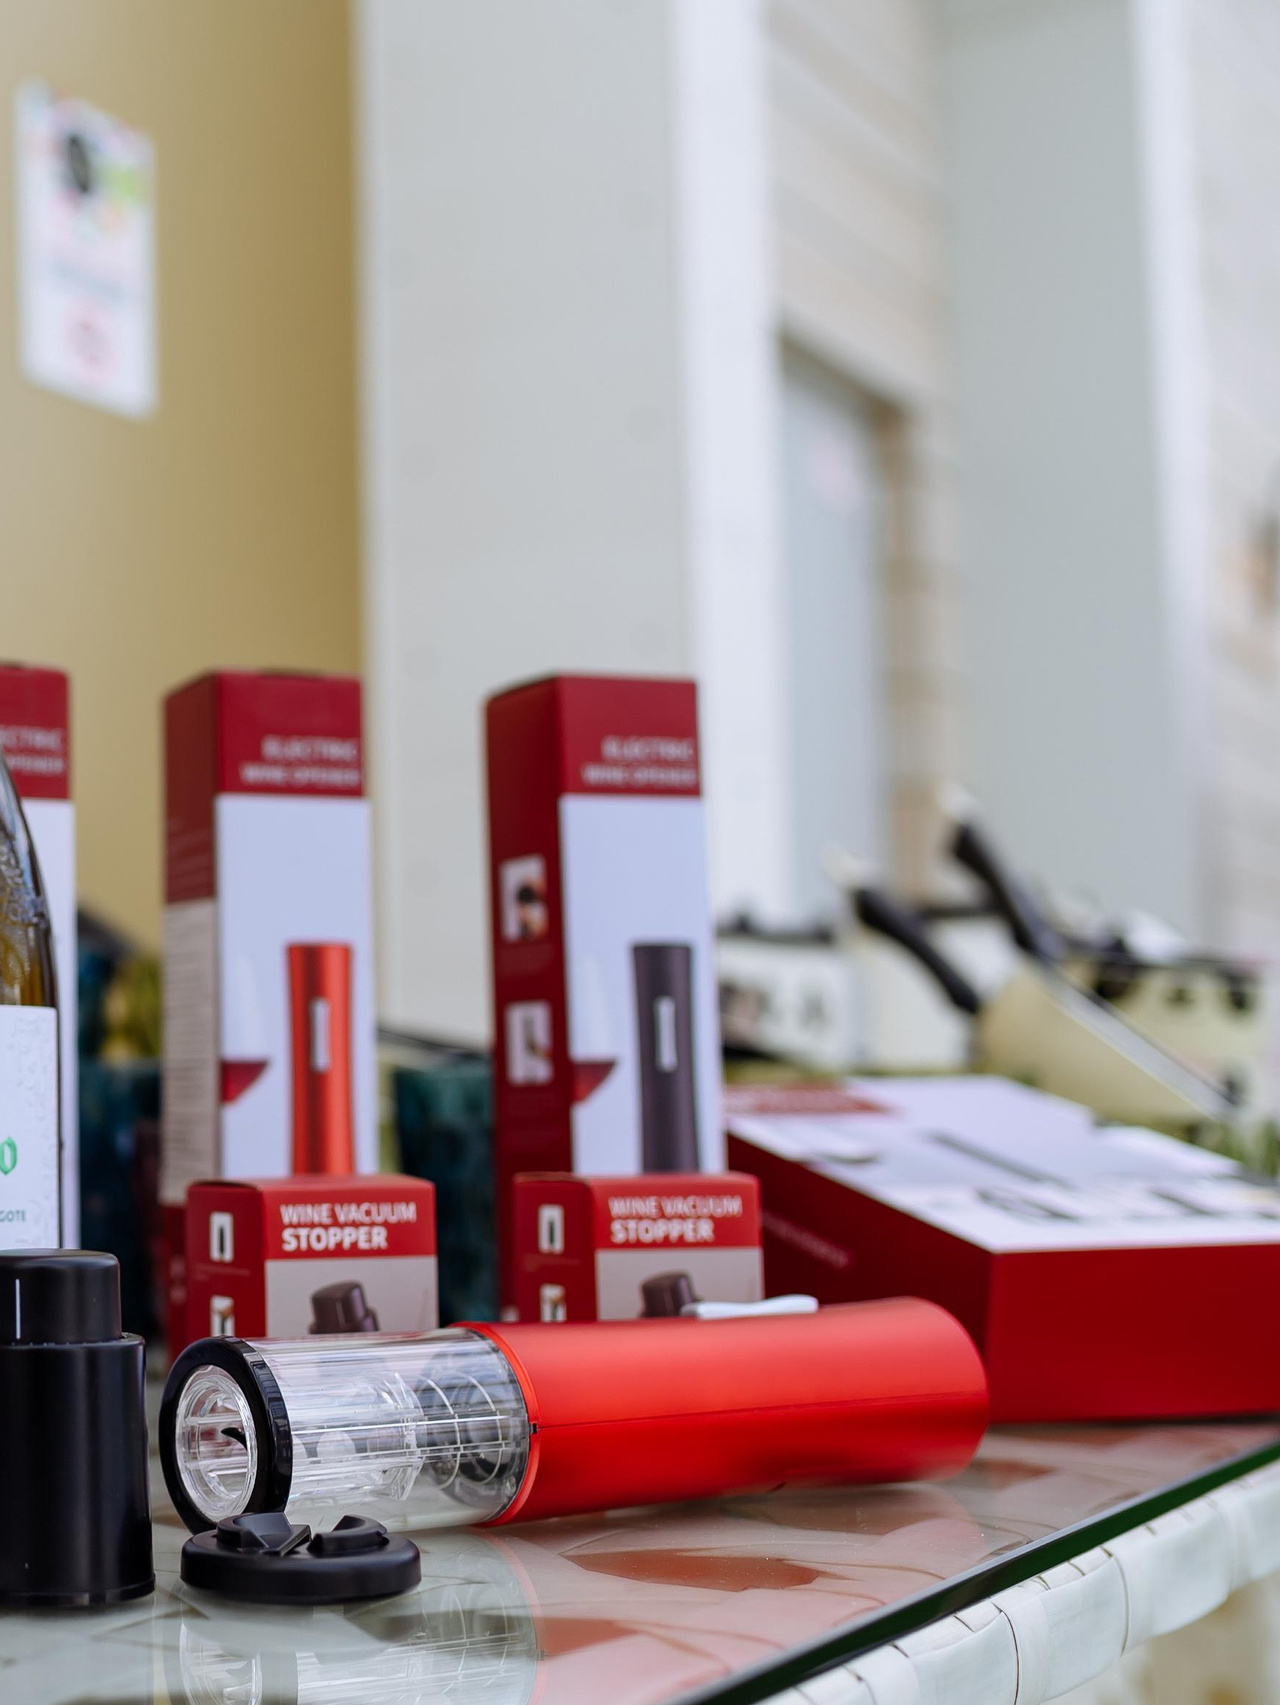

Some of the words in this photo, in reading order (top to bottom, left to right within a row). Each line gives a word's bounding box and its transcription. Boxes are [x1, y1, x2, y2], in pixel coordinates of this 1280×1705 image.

[280, 1202, 333, 1225] WINE
[334, 1201, 417, 1224] VACUUM
[607, 1195, 660, 1219] WINE
[661, 1194, 743, 1218] VACUUM
[282, 1225, 388, 1252] STOPPER
[610, 1218, 715, 1244] STOPPER
